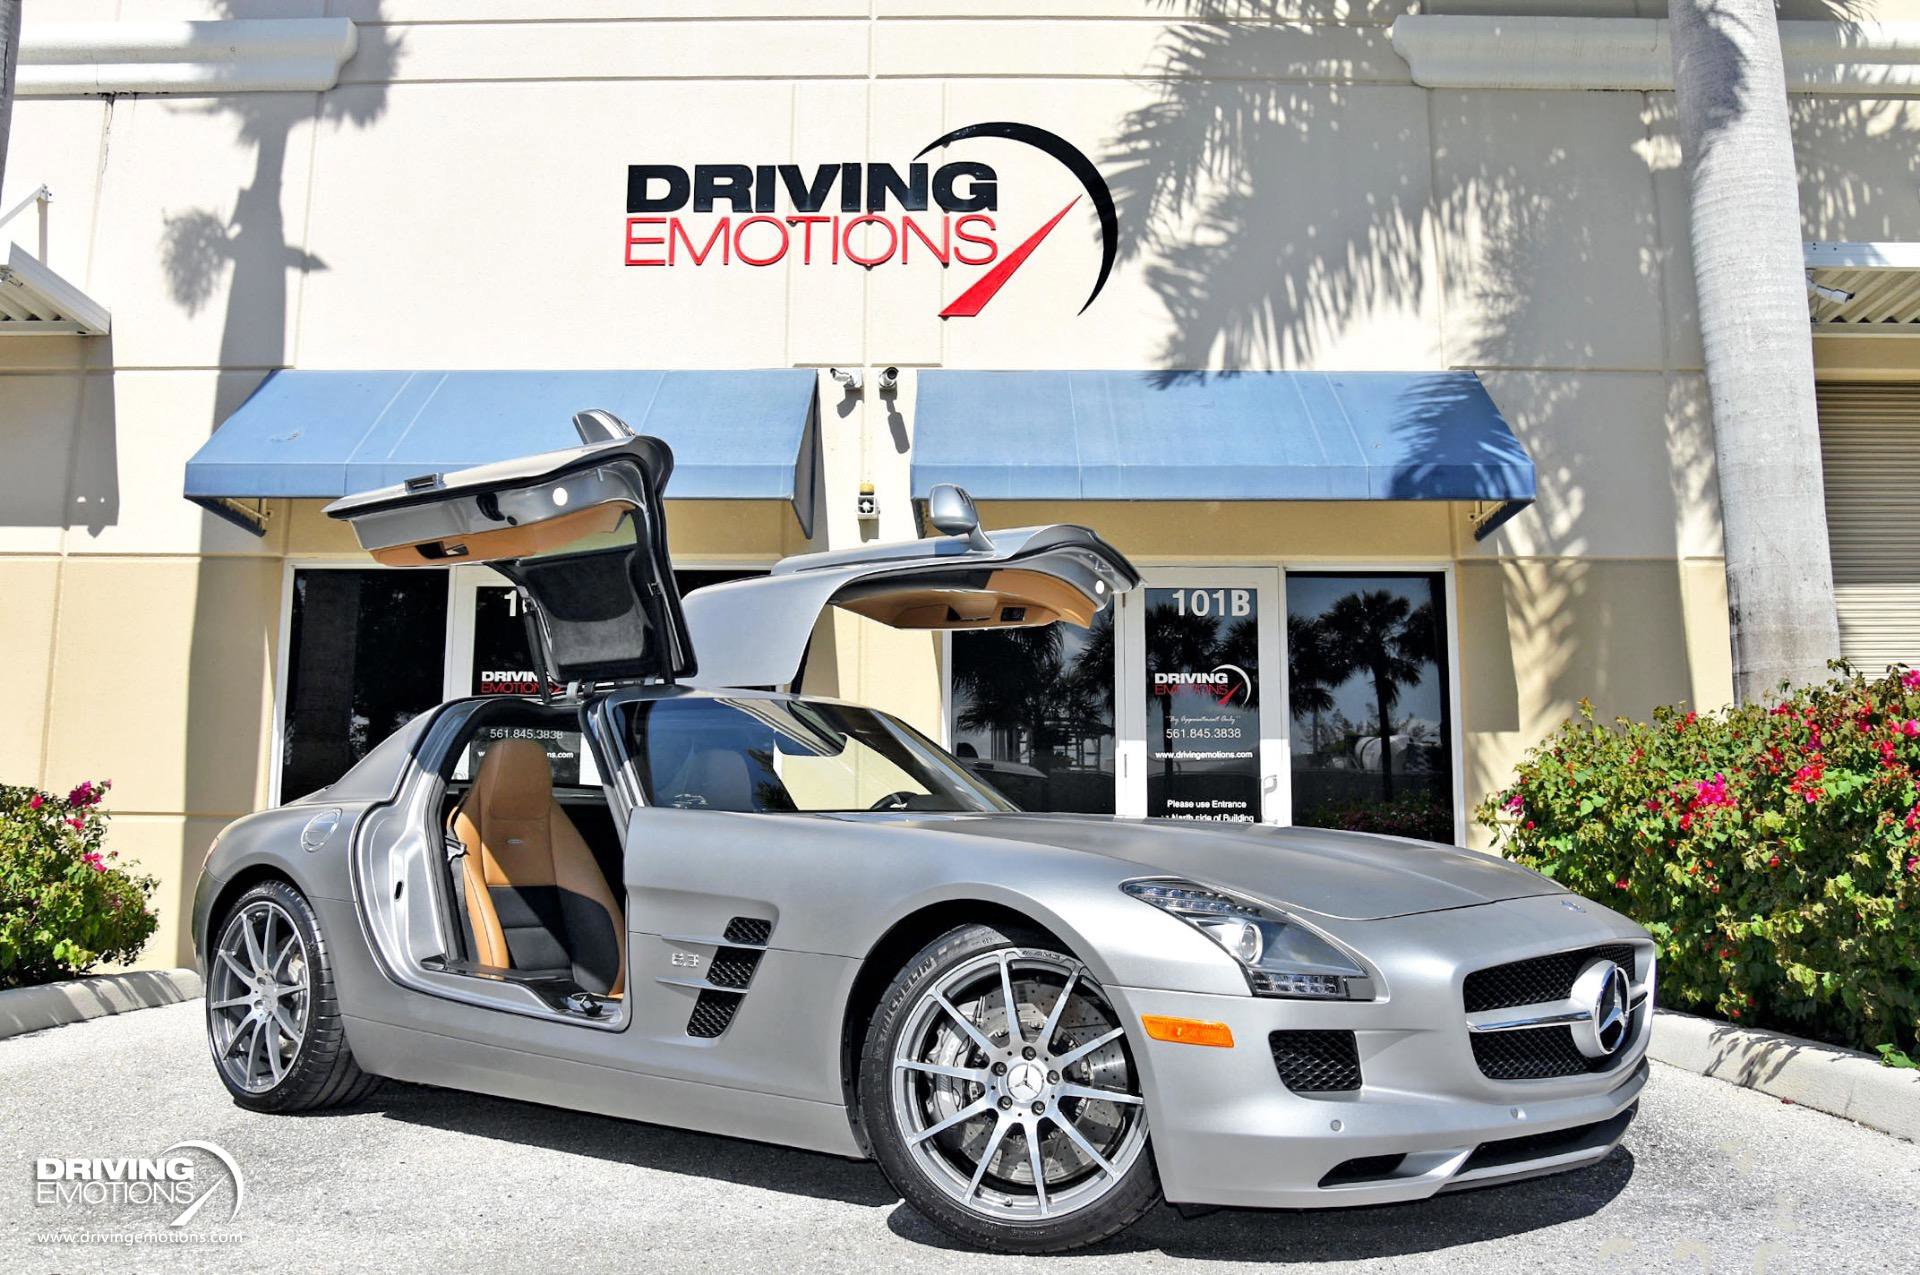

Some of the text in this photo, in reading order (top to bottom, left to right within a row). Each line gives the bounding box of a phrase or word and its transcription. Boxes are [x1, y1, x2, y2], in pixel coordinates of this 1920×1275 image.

[626, 161, 998, 214] DRIVING
[624, 214, 999, 267] EMOTIONS
[1172, 589, 1251, 617] 101B
[1154, 672, 1229, 684] DRIVING
[1154, 684, 1229, 696] EMOTIONS
[490, 728, 564, 740] 561.845.3838
[1166, 728, 1242, 739] 561.845.3838
[1155, 750, 1253, 761] www.drivingemotions.com
[1167, 799, 1248, 809] Please use Entrance
[1223, 814, 1255, 824] Building
